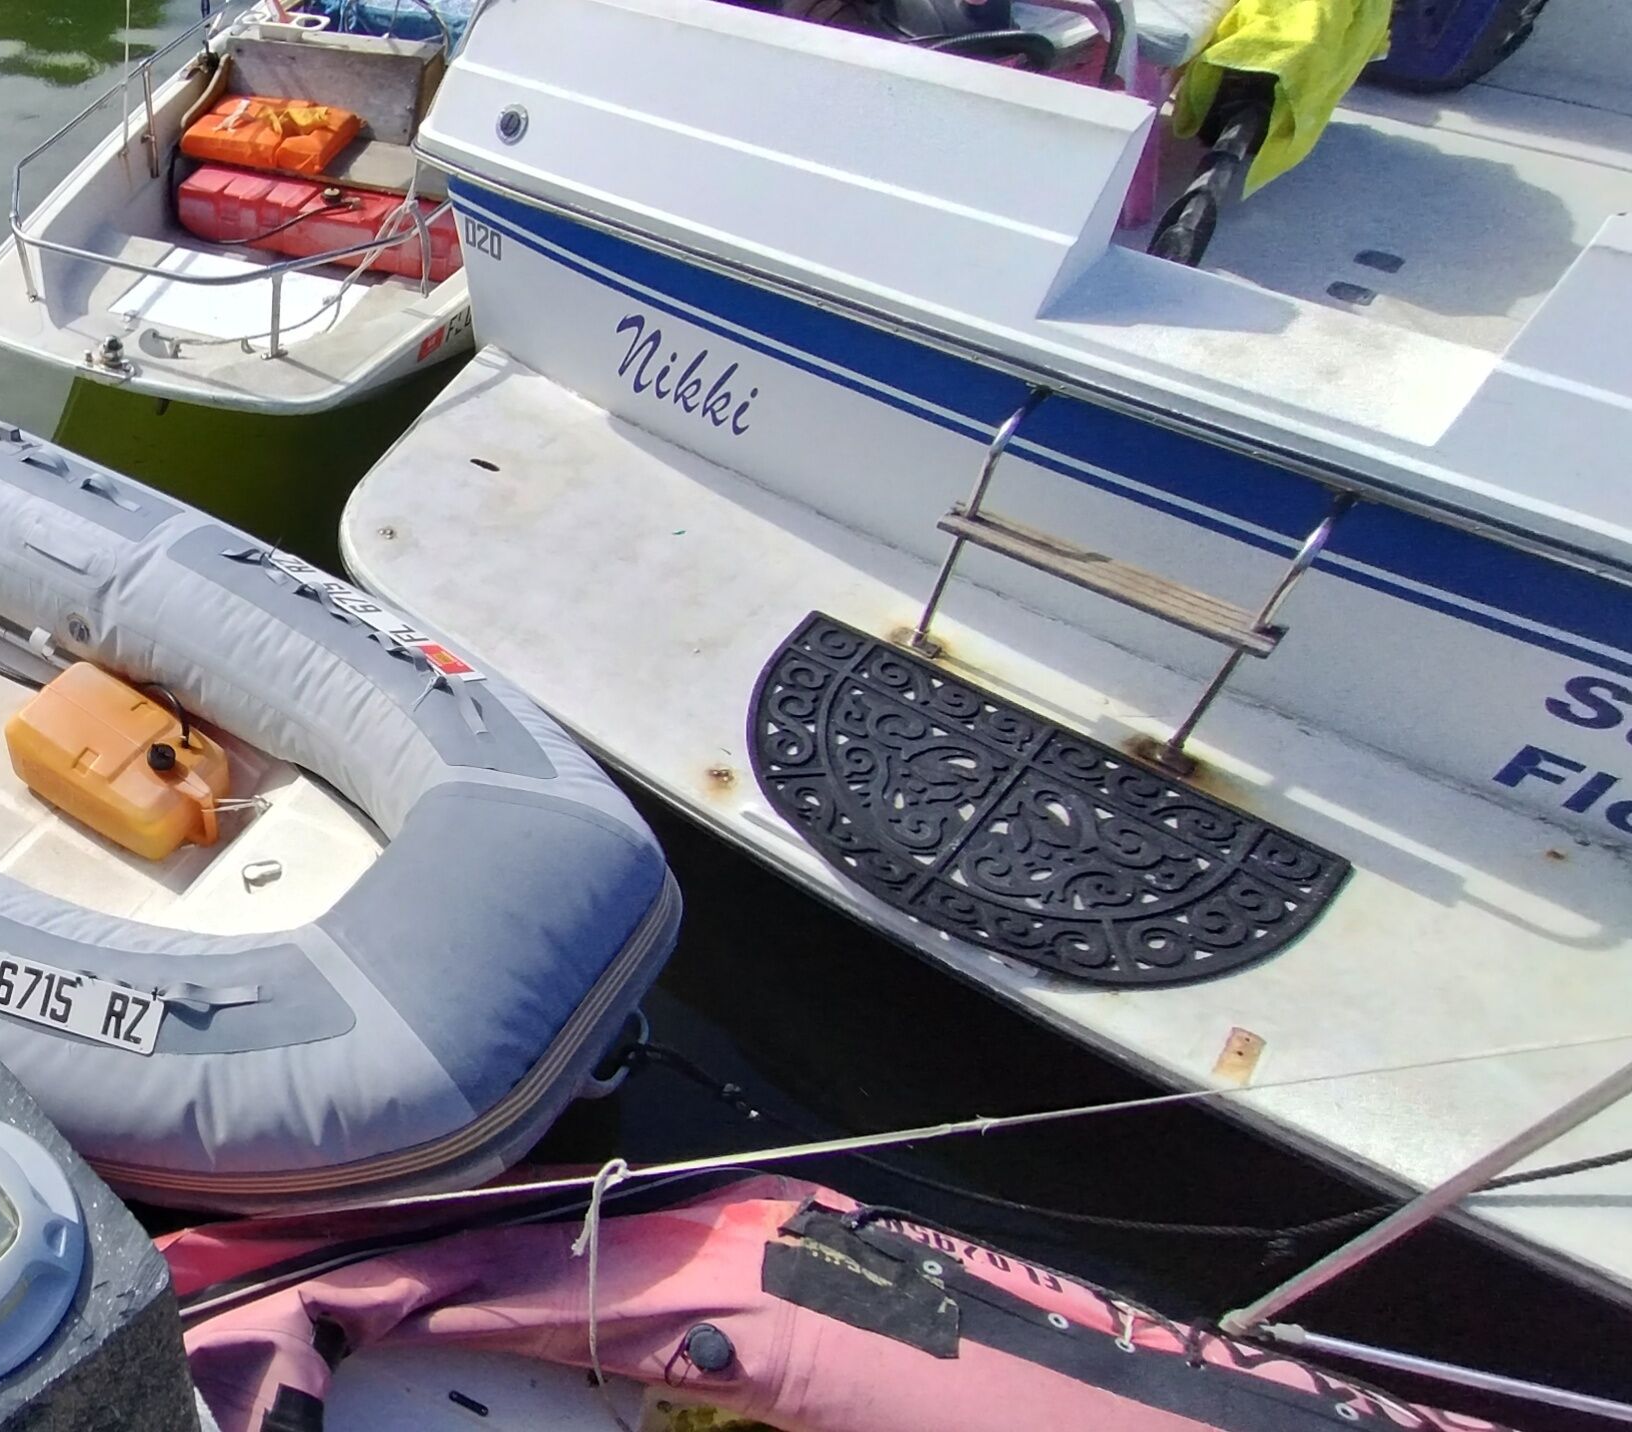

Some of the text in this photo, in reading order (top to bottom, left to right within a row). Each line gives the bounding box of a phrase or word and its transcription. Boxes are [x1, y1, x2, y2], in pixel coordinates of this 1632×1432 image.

[616, 314, 759, 435] Nikki
[324, 582, 382, 613] 6715
[391, 623, 429, 643] FL
[101, 991, 151, 1044] RZ
